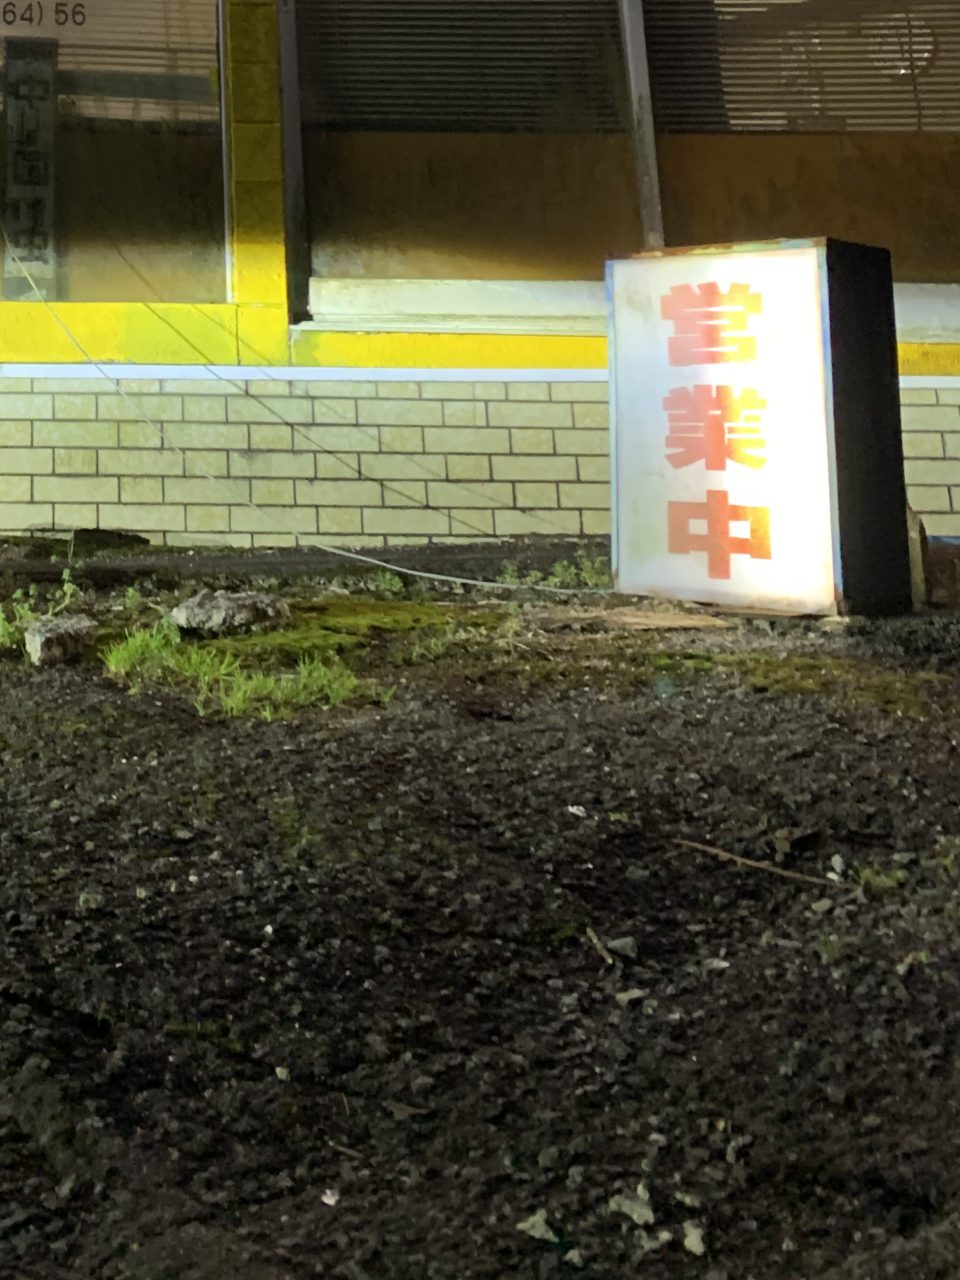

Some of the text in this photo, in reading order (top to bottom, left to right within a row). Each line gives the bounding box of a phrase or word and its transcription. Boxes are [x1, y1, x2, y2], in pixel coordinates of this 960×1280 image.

[54, 3, 86, 26] 56
[660, 281, 772, 580] 営業中
